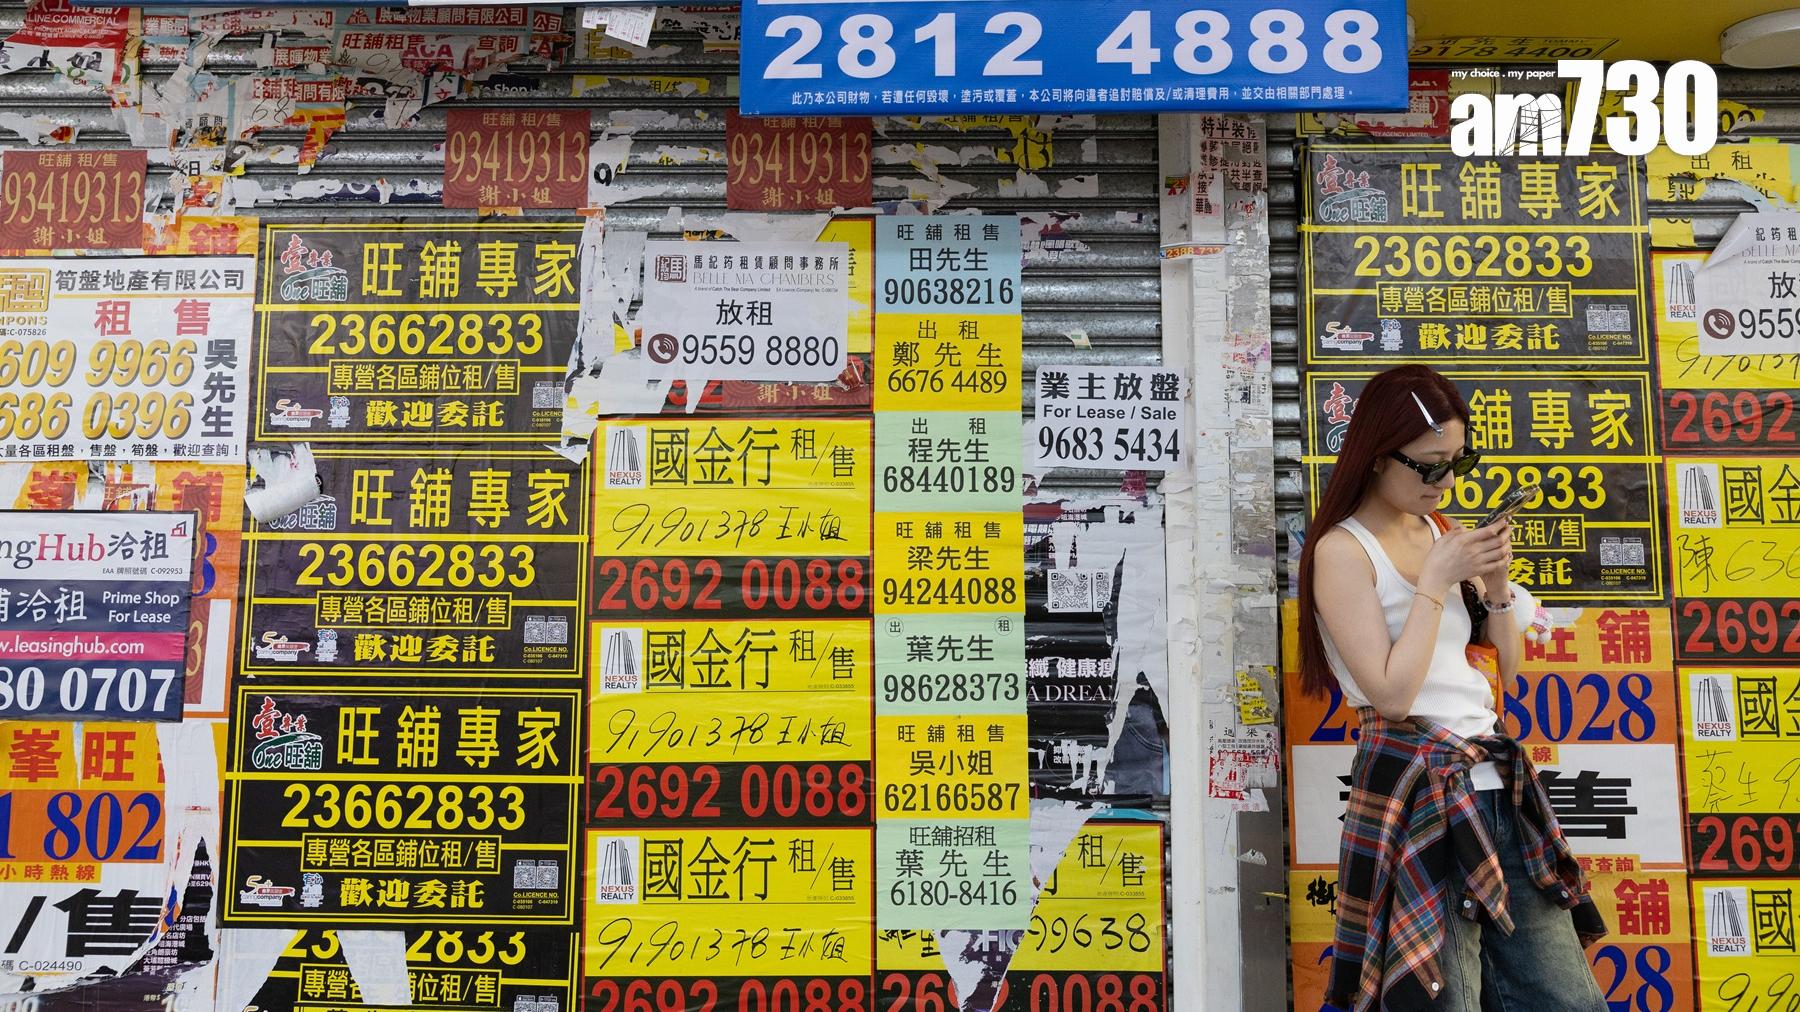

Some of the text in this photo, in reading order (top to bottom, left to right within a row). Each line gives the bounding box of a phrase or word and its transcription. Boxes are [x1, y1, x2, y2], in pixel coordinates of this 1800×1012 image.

[53, 15, 119, 26] COMMERCIAL
[534, 13, 562, 33] 公司
[763, 8, 1383, 80] 2812 4888
[1504, 46, 1594, 58] 4400
[483, 112, 561, 126] 旺舖 租/售
[39, 153, 118, 167] 旺舖 租/售
[449, 130, 586, 184] 93419313
[731, 132, 869, 187] 93419313
[3, 171, 142, 225] 93419313
[478, 186, 553, 207] 謝小姐
[762, 187, 837, 208] 謝小姐
[1401, 161, 1621, 221] 旺舖專家
[33, 226, 108, 246] 謝小姐
[897, 223, 1000, 242] 旺舖租售
[362, 240, 577, 299] 旺舖專家
[909, 247, 989, 273] 田先生
[1353, 235, 1593, 278] 23662833
[55, 268, 245, 292] 筍盤地產有限公司
[693, 272, 835, 286] BELLE MA CHAMBERS
[884, 278, 1014, 305] 90638216
[715, 299, 773, 326] 放租
[1381, 285, 1567, 313] 專營各區鋪位租/售
[308, 313, 544, 355] 23662833
[918, 319, 980, 340] 出租
[1418, 322, 1561, 350] 歡迎委託
[84, 339, 198, 388] 9966
[682, 334, 839, 367] 9559 8880
[892, 341, 1004, 368] 鄭先生
[201, 339, 239, 438] 吳先生
[332, 362, 517, 392] 專營各區鋪位租/售
[888, 369, 1007, 394] 6676 4489
[1041, 371, 1180, 401] 業主放盤
[82, 391, 195, 441] 0396
[365, 400, 505, 428] 歡迎委託
[1043, 404, 1072, 418] For
[1077, 405, 1126, 419] Lease
[1141, 406, 1177, 420] Sale
[1669, 391, 1796, 443] 2692
[650, 425, 780, 487] 國金行
[908, 438, 990, 464] 程先生
[1038, 426, 1180, 462] 9683 5434
[883, 466, 1015, 493] 68440189
[350, 467, 570, 529] 旺舖專家
[896, 521, 1001, 539] 旺舖租售
[102, 567, 115, 575] EAA
[151, 567, 184, 575] C-092953
[295, 543, 536, 588] 23662833
[907, 545, 990, 571] 梁先生
[102, 590, 180, 608] Prime Shop
[598, 559, 865, 610] 2692 0088
[882, 578, 1017, 605] 94244088
[108, 610, 172, 624] For Lease
[320, 596, 508, 625] 專營各區鋪位租/售
[353, 634, 495, 663] 歡迎委託
[645, 627, 778, 690] 國金行
[906, 634, 994, 663] 葉先生
[59, 667, 176, 713] 0707
[883, 673, 1019, 702] 98628373
[1046, 684, 1113, 702] DREA
[336, 705, 561, 769] 旺舖專家
[897, 724, 1005, 743] 旺舖租售
[253, 741, 323, 770] One 旺舖
[909, 750, 993, 777] 吳小姐
[594, 764, 866, 818] 2692 0088
[884, 783, 1021, 812] 62166587
[281, 783, 526, 831] 23662833
[43, 792, 164, 861] 802
[909, 825, 997, 847] 旺舖招租
[305, 838, 497, 869] 專營各區鋪位租/售
[895, 849, 1012, 879] 葉先生
[642, 836, 778, 901] 國金行
[339, 878, 485, 909] 歡迎委託
[600, 892, 634, 900] REALTY
[890, 880, 1017, 906] 6180-8416
[18, 961, 83, 972] C-024490
[590, 979, 865, 1012] 2692 0088
[1029, 973, 1158, 1012] 0088
